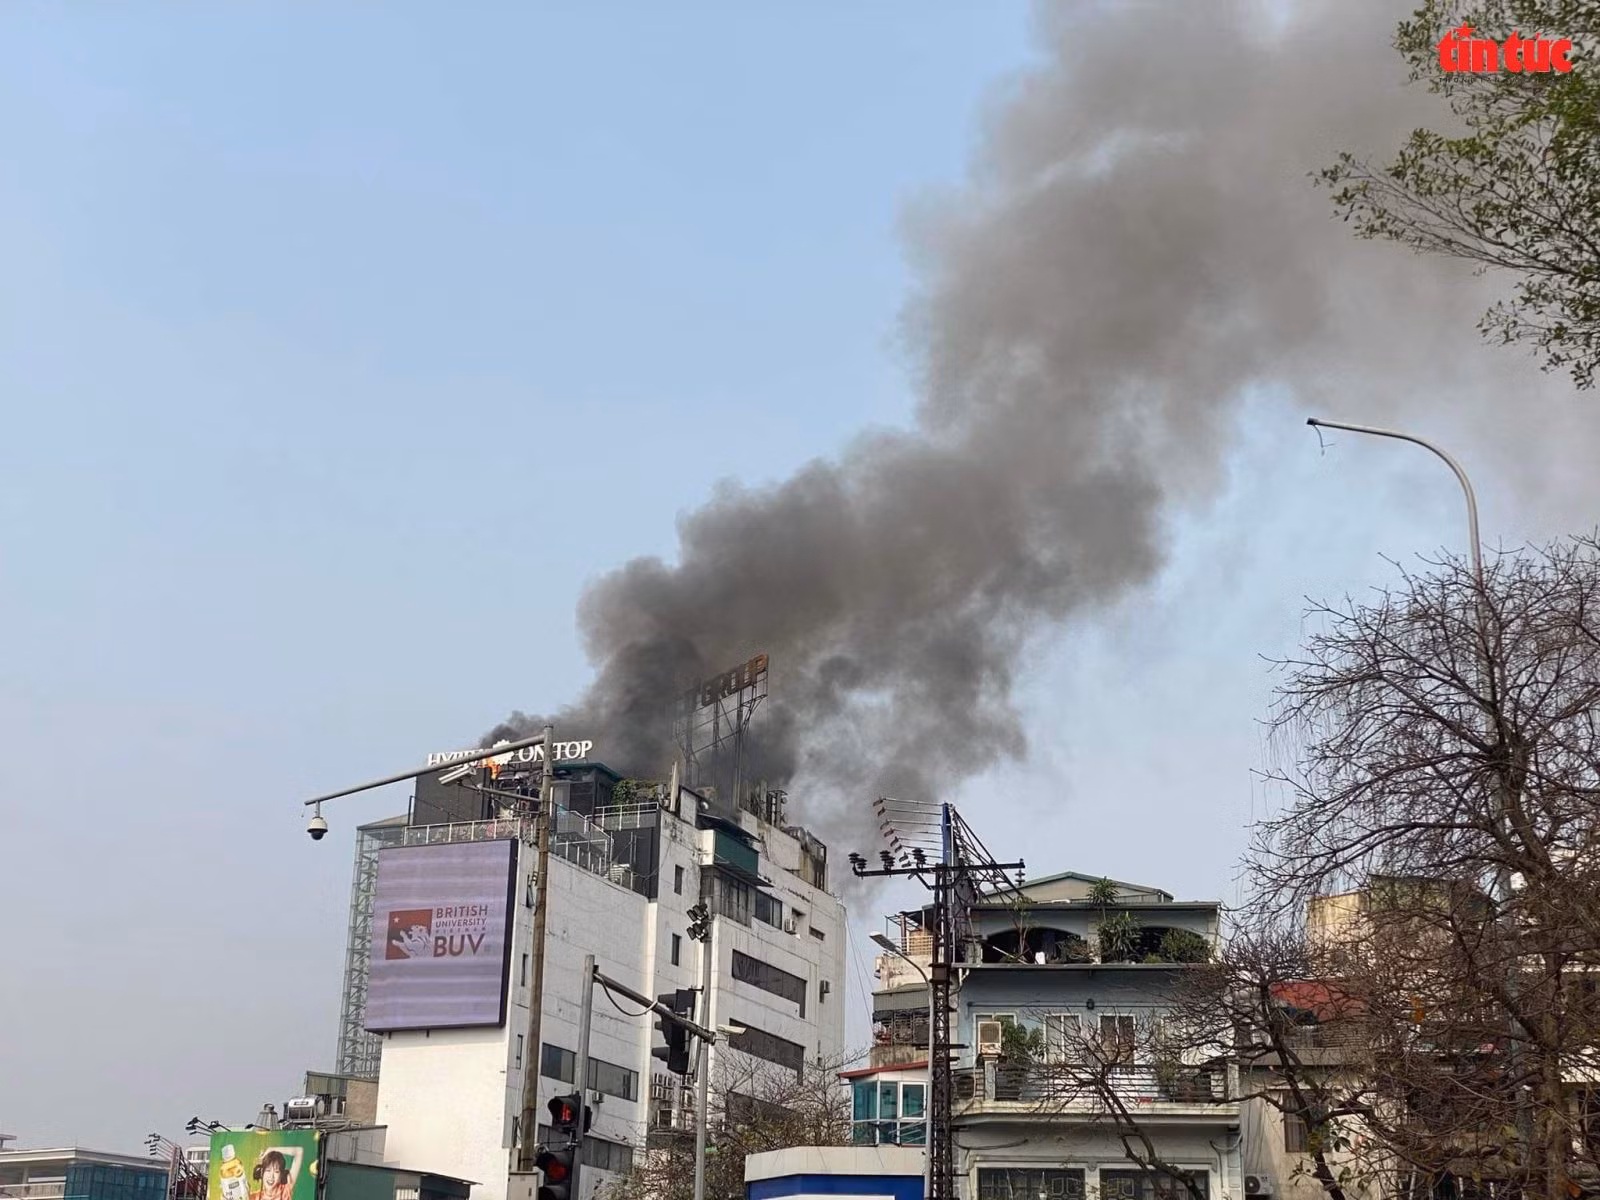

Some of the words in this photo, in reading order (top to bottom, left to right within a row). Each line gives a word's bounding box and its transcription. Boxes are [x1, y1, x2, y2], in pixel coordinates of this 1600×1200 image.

[552, 740, 593, 760] TOP
[436, 905, 488, 918] BRITISH
[435, 918, 487, 928] UNIVERSITY
[433, 933, 486, 957] BUV
